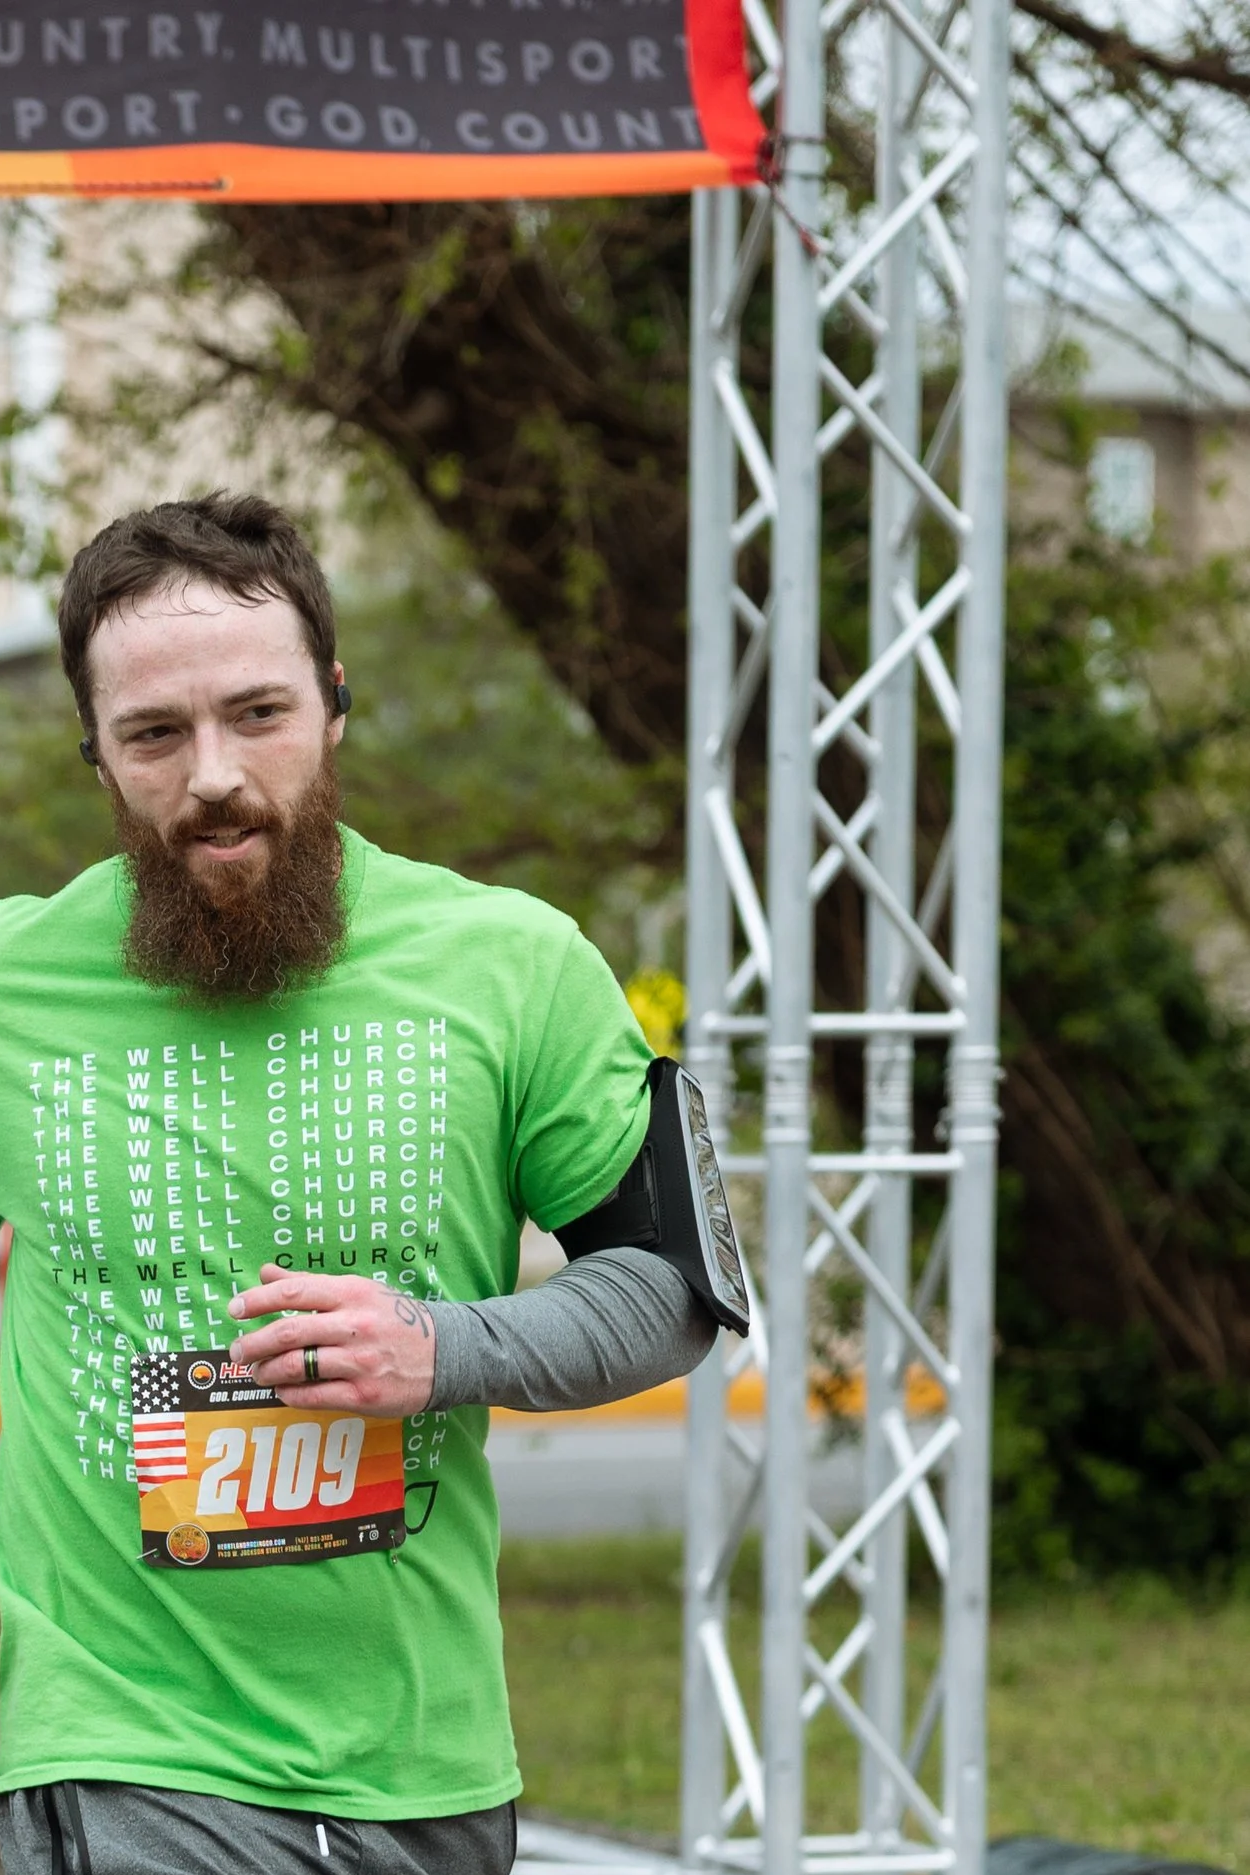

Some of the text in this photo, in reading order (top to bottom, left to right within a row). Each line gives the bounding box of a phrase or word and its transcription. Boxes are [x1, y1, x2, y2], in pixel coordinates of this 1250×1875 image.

[260, 16, 688, 85] MULTISPOR
[29, 1018, 446, 1078] THE WELL CHURCH
[29, 1041, 447, 1100] THE WELL CHURCH
[32, 1066, 447, 1124] THE WELL CHURCH
[33, 1091, 447, 1148] THE WELL CHURCH
[35, 1117, 447, 1172] THE WELL CHURCH
[37, 1142, 445, 1195] THE WELL CHURCH
[40, 1167, 444, 1218] THE WELL CHURCH
[46, 1192, 443, 1240] THE WELL CHURCH
[50, 1216, 440, 1262] THE WELL CHURCH
[52, 1242, 439, 1285] THE WELL CHURCH
[69, 1290, 115, 1310] HE
[143, 1308, 252, 1331] WEL
[70, 1325, 128, 1351] THE
[209, 1390, 230, 1403] GOD.
[232, 1388, 273, 1402] COUNTRY.
[76, 1410, 131, 1441] TE
[78, 1457, 138, 1483] THE
[195, 1416, 366, 1516] 2109
